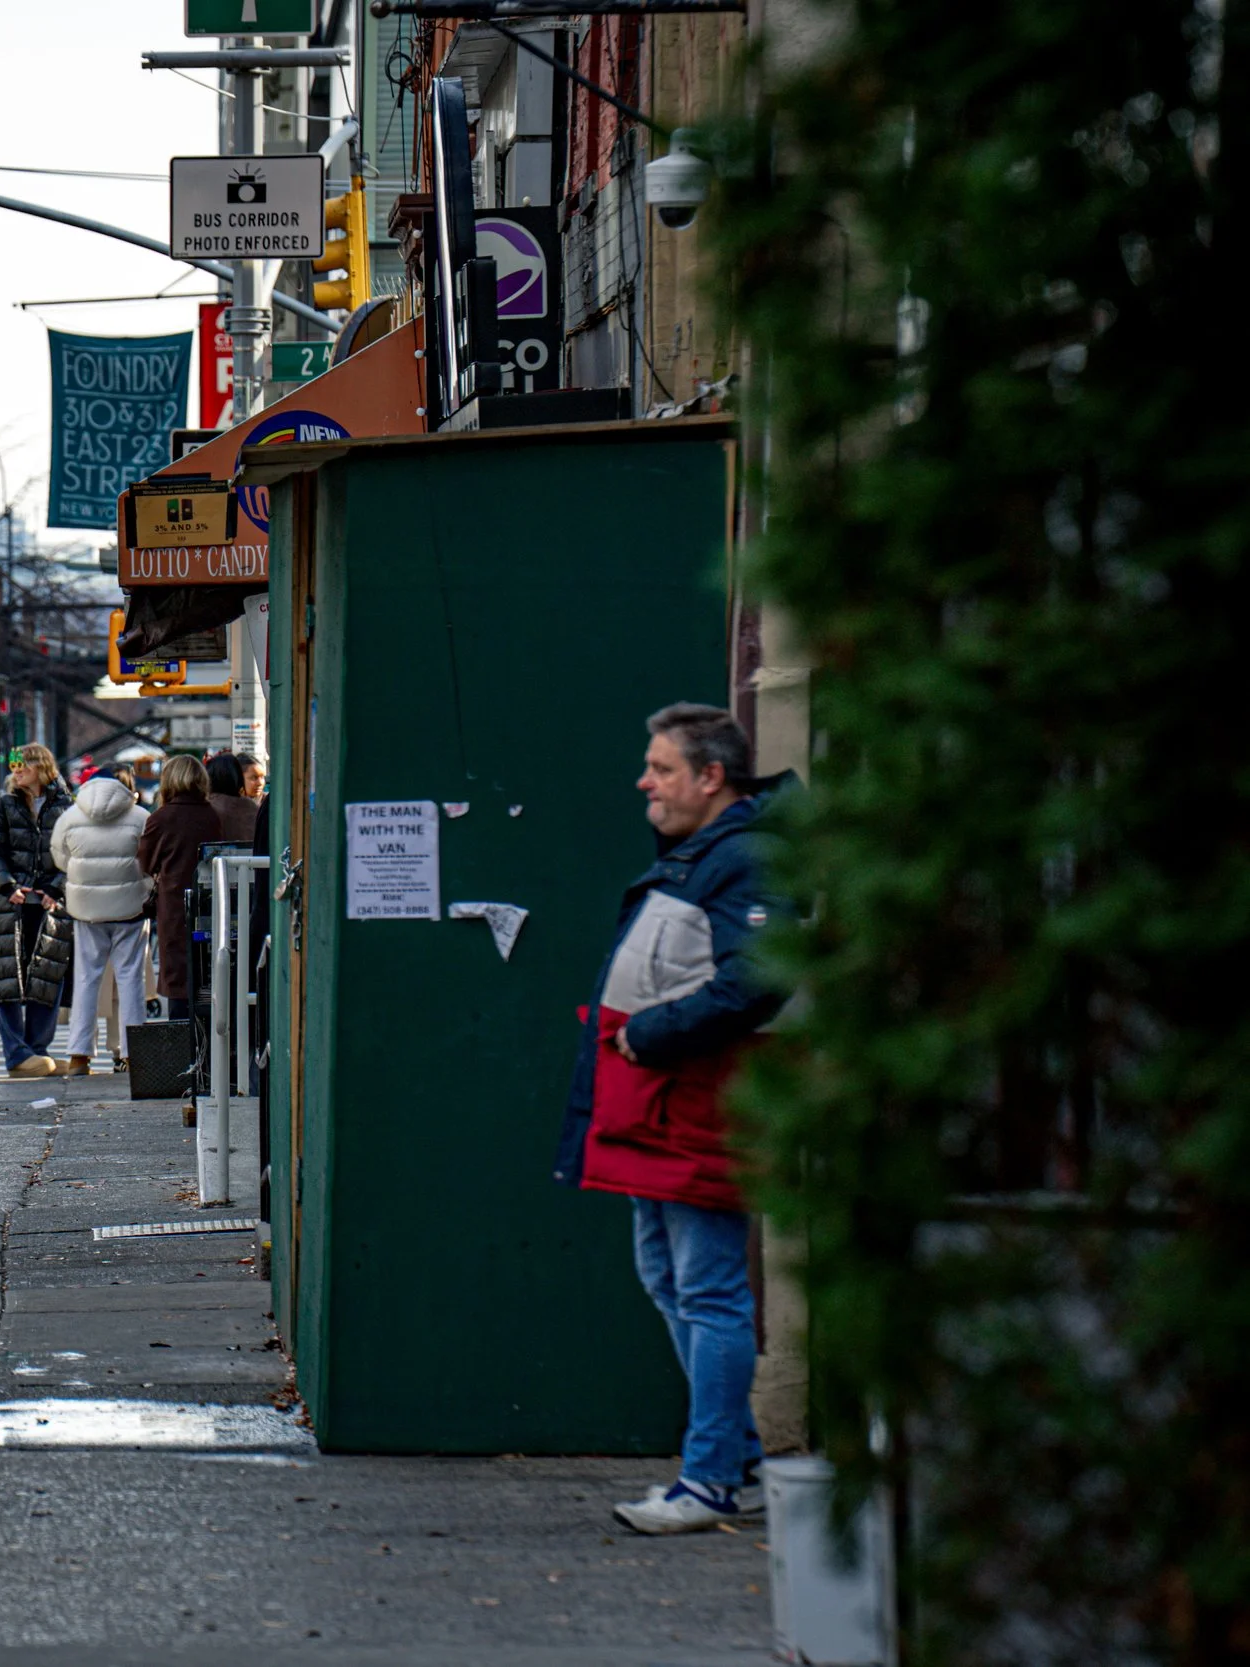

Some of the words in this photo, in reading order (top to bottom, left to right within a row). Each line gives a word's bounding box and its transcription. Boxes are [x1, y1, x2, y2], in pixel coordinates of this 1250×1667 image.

[194, 213, 222, 228] BUS
[229, 212, 300, 227] CORRIDOR
[184, 236, 230, 251] PHOTO
[235, 235, 309, 250] ENFORCED
[301, 348, 314, 376] 2
[62, 351, 179, 393] FOUNDRY
[62, 430, 127, 463] EAST
[131, 435, 165, 464] 23
[59, 502, 92, 517] NEW
[97, 505, 117, 518] YO
[129, 547, 189, 578] LOTTO
[207, 545, 269, 577] CANDY
[361, 807, 387, 818] THE
[391, 806, 422, 817] MAN
[358, 825, 394, 836] WITH
[397, 824, 425, 835] THE
[377, 843, 406, 854] VAN
